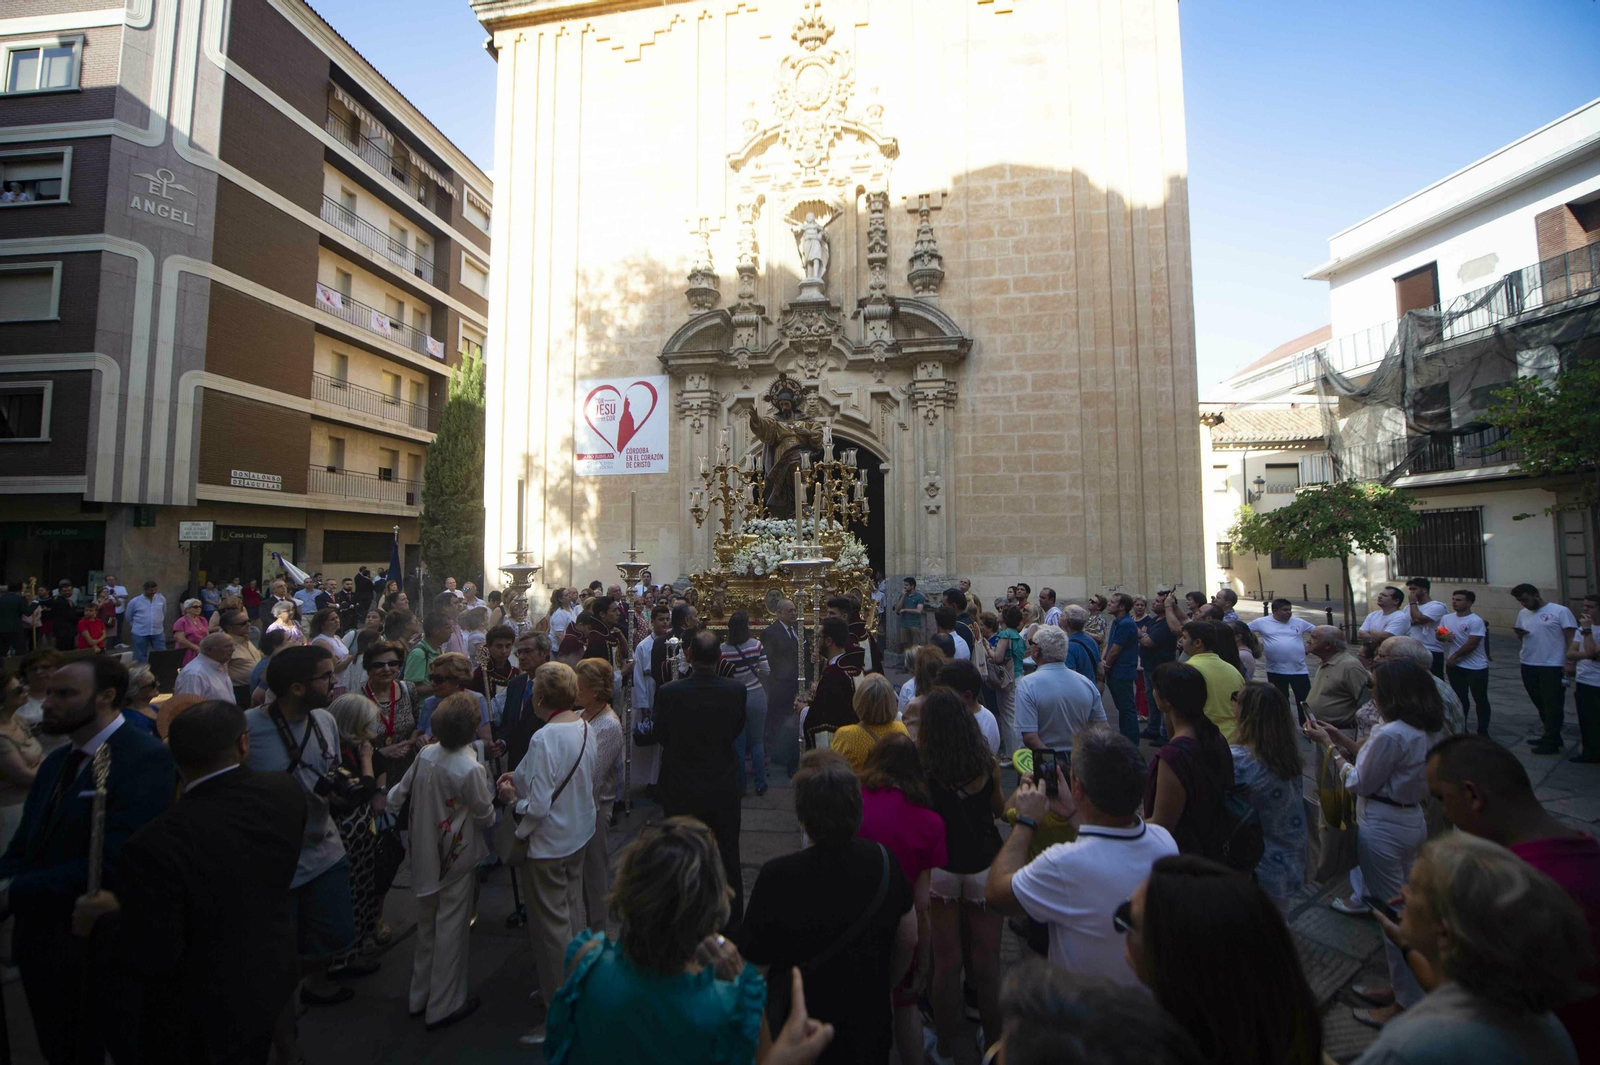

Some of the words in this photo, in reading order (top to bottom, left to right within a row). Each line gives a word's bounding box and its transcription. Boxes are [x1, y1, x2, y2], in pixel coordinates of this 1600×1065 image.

[148, 178, 174, 202] EL
[130, 195, 195, 227] ANGEL
[595, 403, 616, 415] JESU
[641, 453, 664, 461] CORAZÓN
[251, 473, 281, 482] ALONSO
[245, 480, 281, 489] AGUILAR
